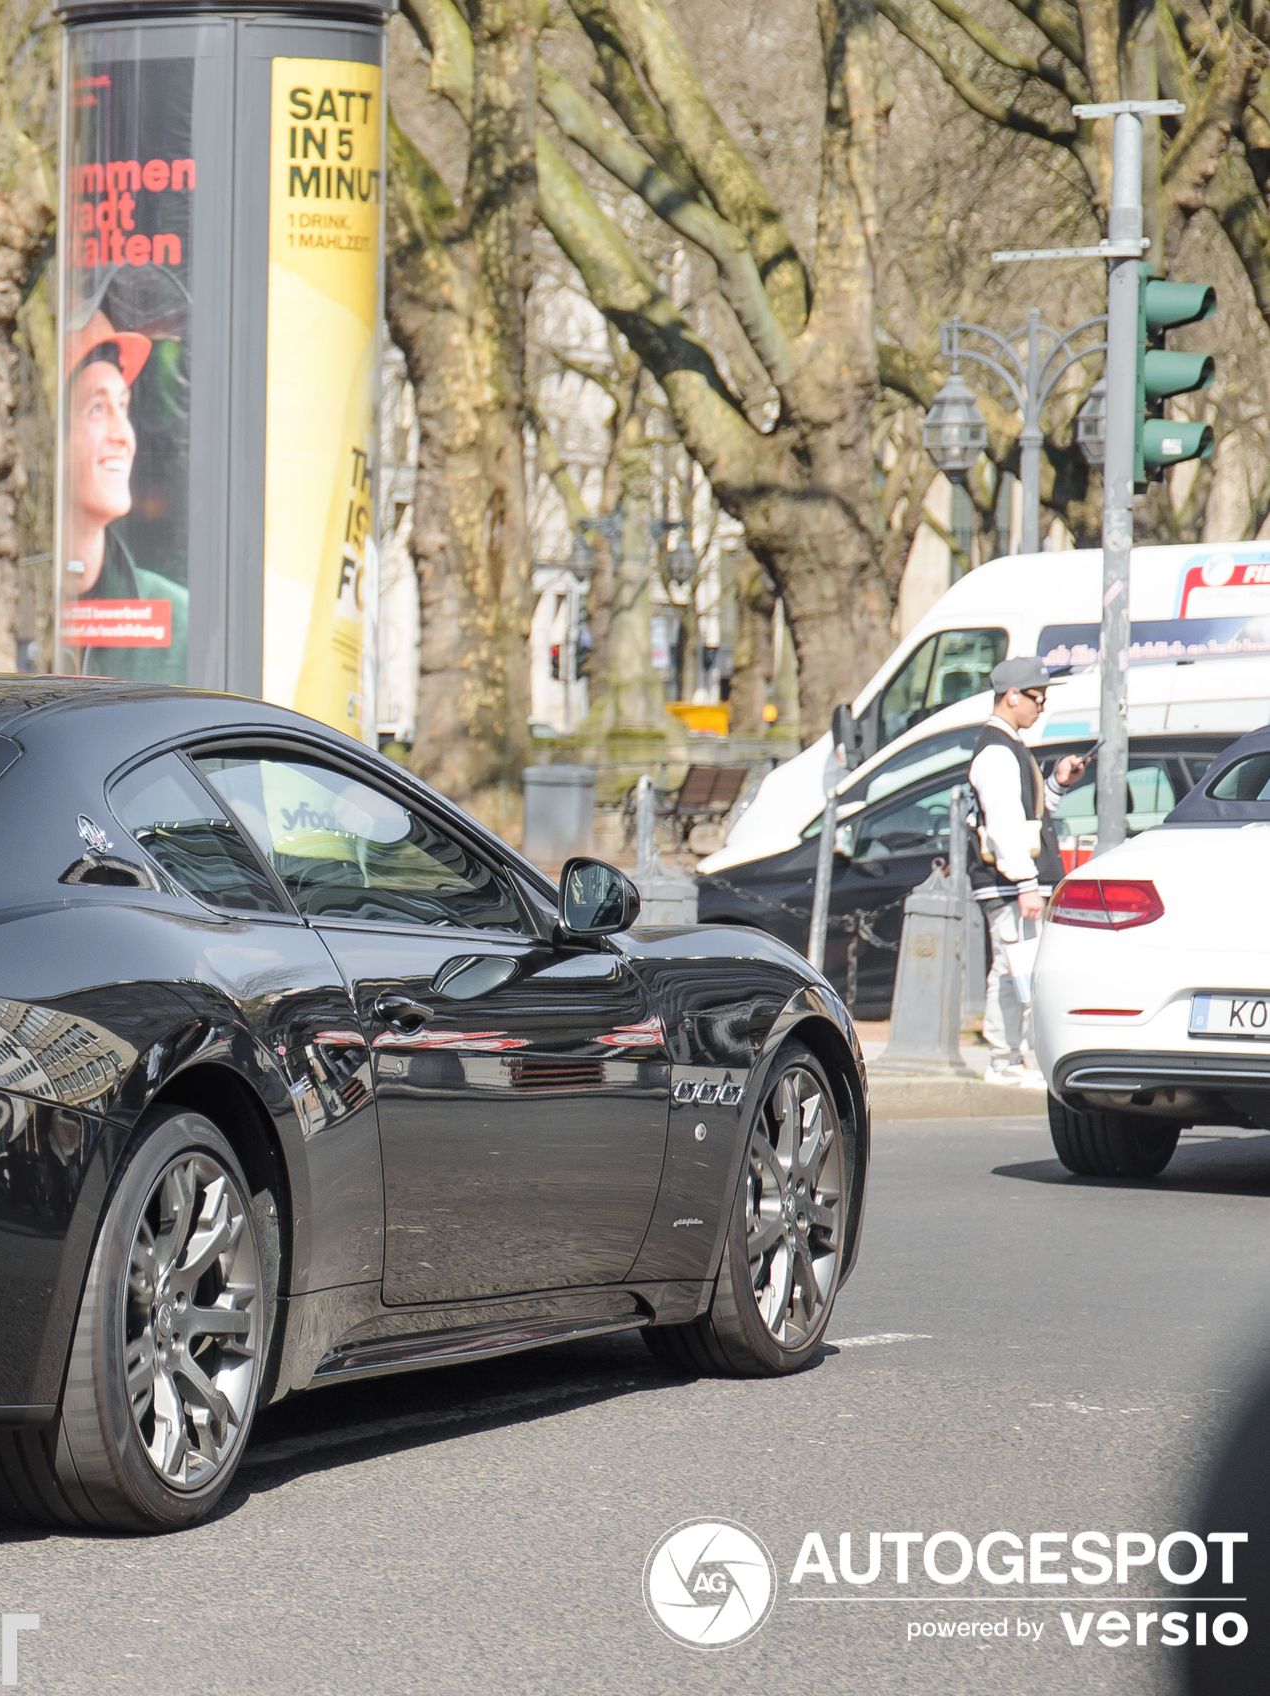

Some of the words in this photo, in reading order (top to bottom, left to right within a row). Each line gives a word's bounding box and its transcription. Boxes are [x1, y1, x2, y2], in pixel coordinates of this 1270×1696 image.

[288, 87, 372, 125] SATT
[289, 126, 327, 160] IN
[337, 128, 354, 161] 5
[1230, 1000, 1268, 1028] KO
